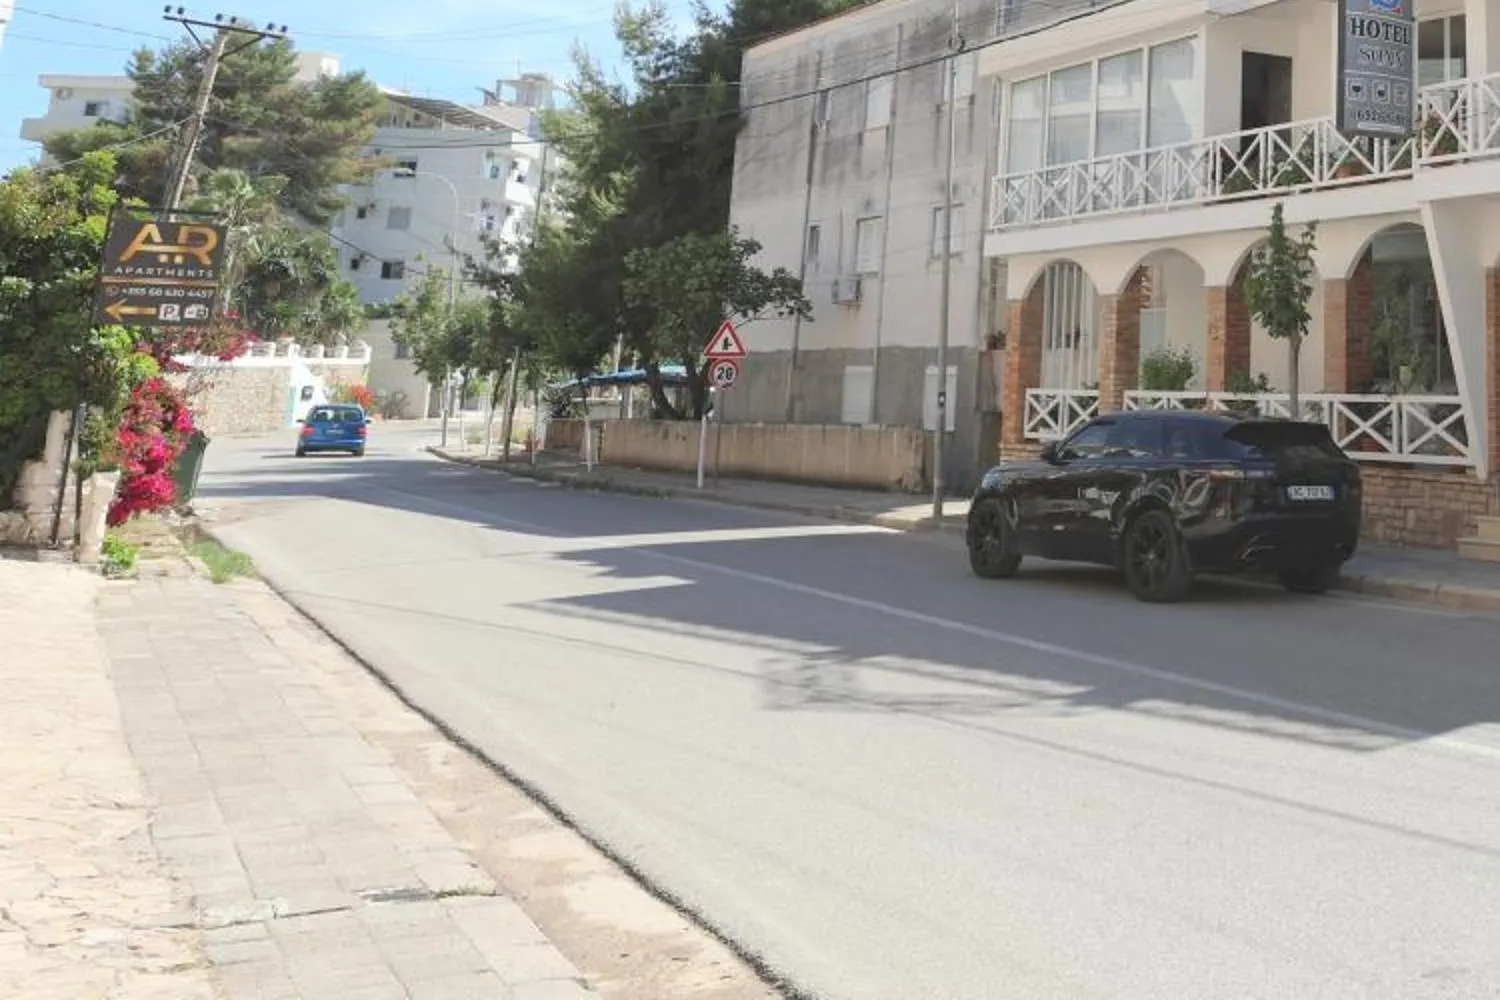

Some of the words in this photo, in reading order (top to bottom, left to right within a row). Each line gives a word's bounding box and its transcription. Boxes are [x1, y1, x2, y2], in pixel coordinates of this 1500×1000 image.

[1350, 16, 1408, 45] HOTEL
[114, 266, 214, 278] APARTMENTS
[717, 366, 733, 380] 20
